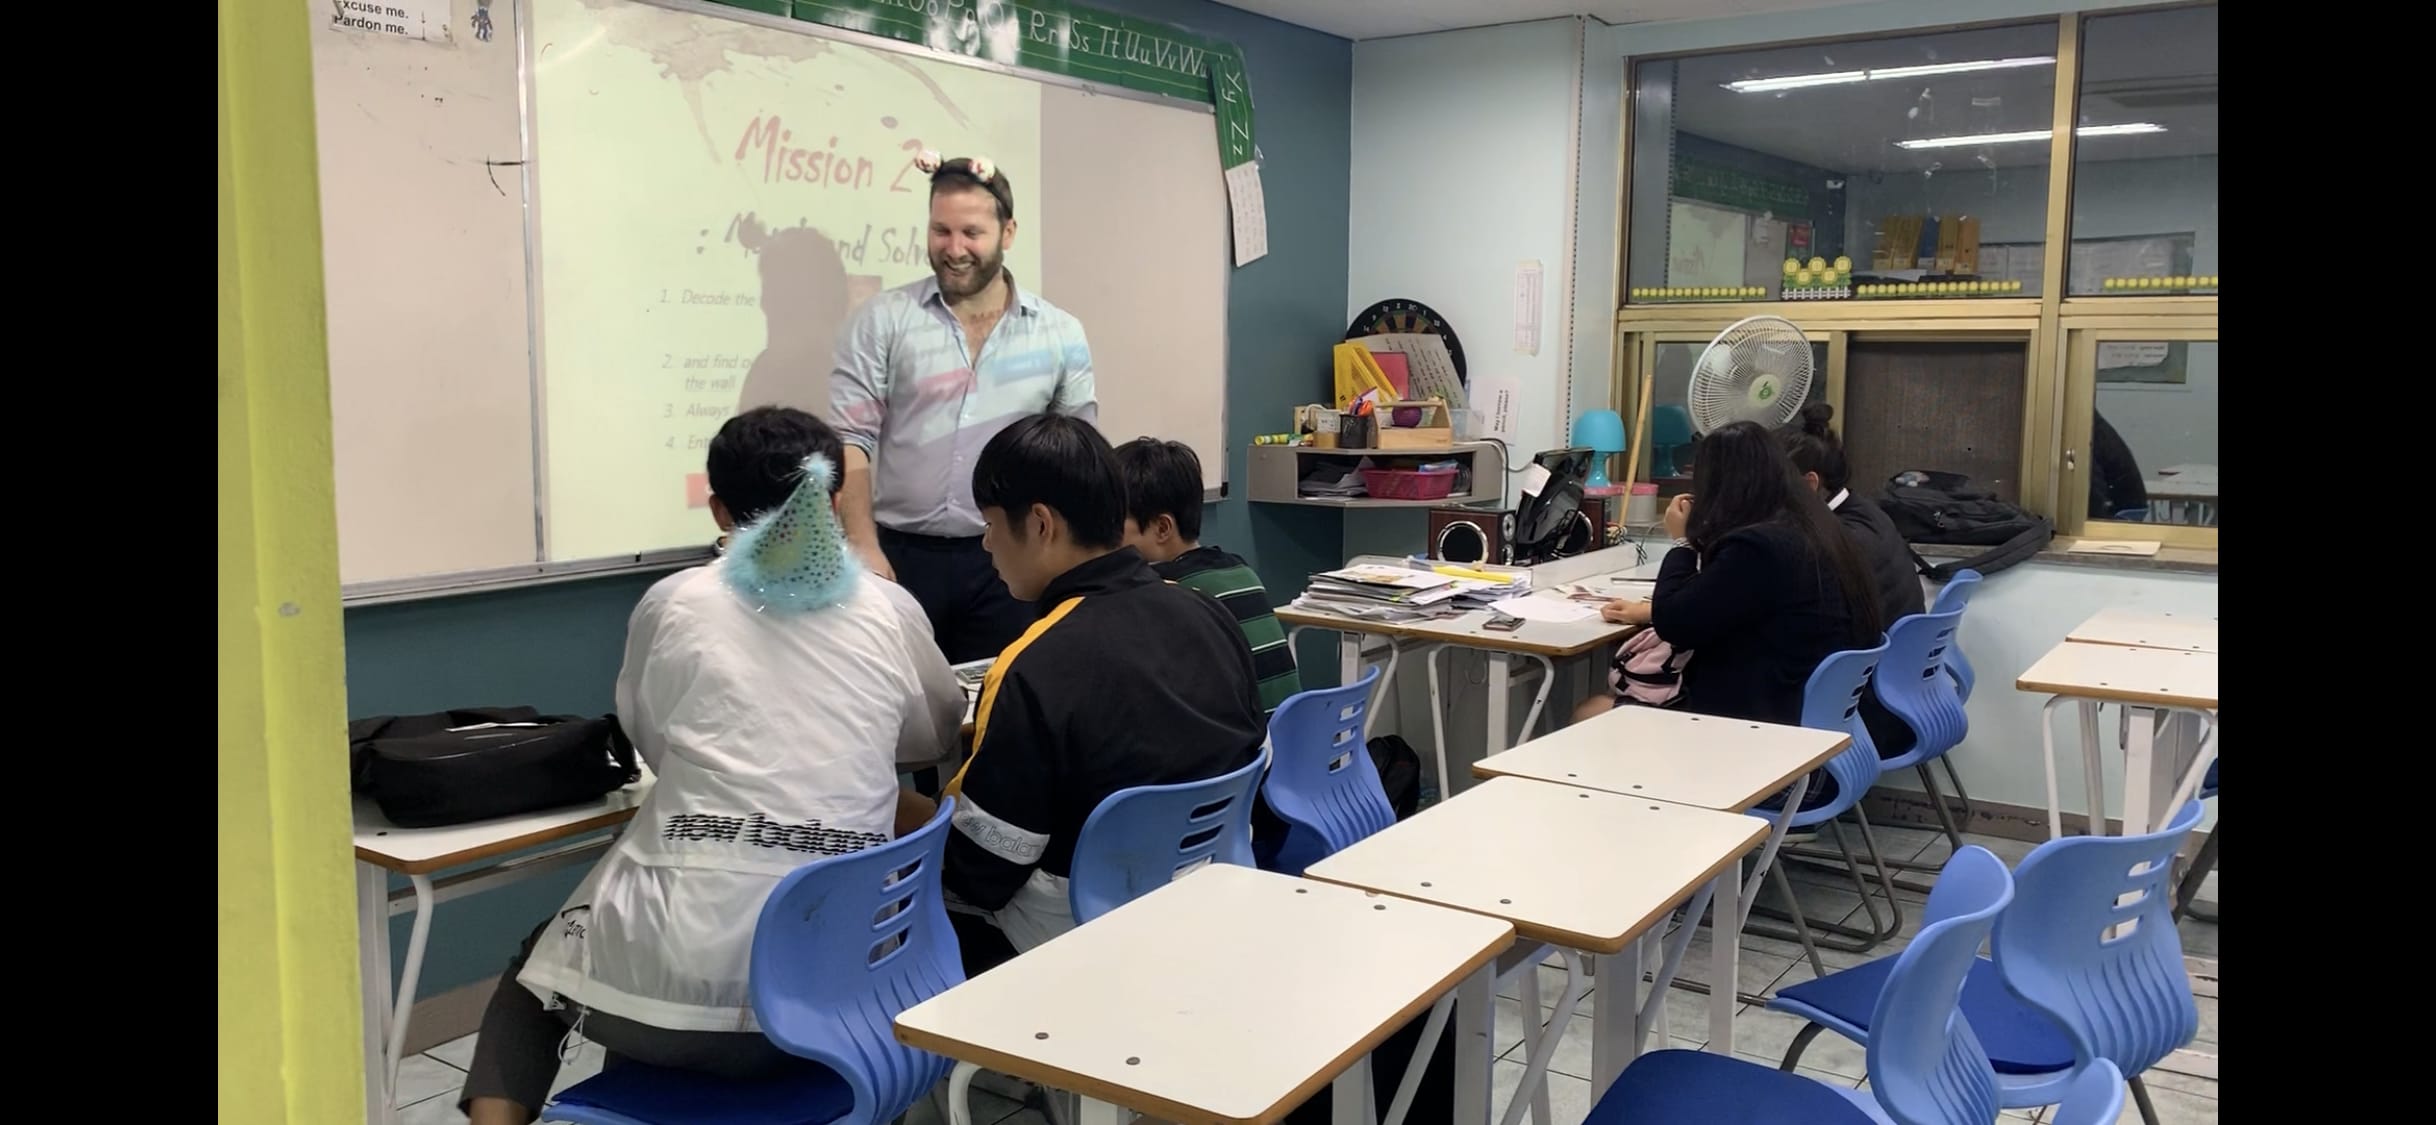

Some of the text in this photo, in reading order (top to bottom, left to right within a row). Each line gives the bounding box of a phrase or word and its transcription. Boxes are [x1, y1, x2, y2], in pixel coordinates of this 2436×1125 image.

[334, 14, 409, 35] Pardon me.
[386, 7, 409, 19] me.
[1029, 10, 1056, 45] Rr
[1069, 19, 1090, 53] Ss
[1099, 26, 1120, 59] Tt
[1125, 30, 1151, 65] Uu
[1154, 37, 1178, 70] Vv
[1221, 71, 1243, 104] Yy
[1231, 120, 1249, 156] Zz
[734, 115, 924, 193] Mission 2
[836, 224, 872, 267] nd
[681, 289, 731, 306] Decode
[735, 292, 756, 307] the
[683, 355, 709, 369] and
[712, 354, 739, 369] find
[685, 375, 737, 390] the wall
[686, 402, 730, 421] Always
[687, 434, 710, 450] Ent
[662, 812, 889, 856] new balanc
[985, 824, 1042, 857] bala
